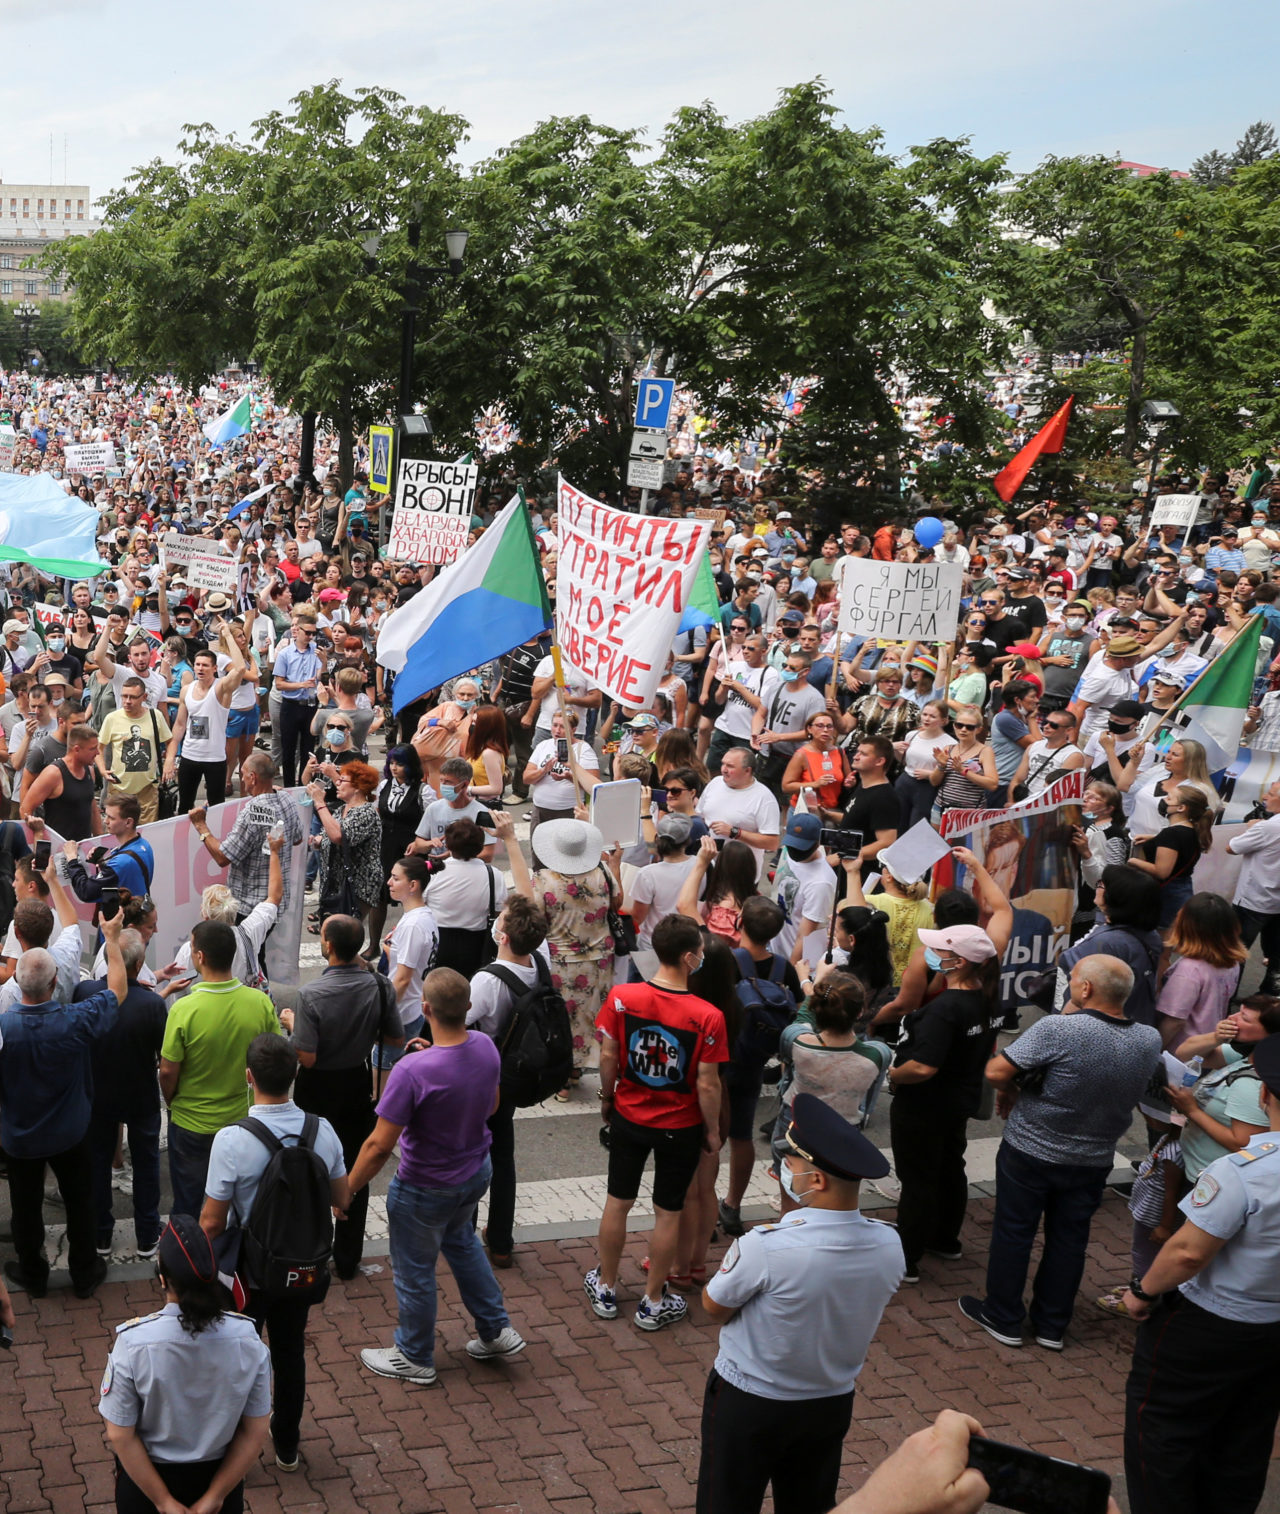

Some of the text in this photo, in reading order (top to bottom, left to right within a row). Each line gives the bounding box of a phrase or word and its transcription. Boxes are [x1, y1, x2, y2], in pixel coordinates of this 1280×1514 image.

[402, 484, 475, 516] ВОН!
[395, 511, 466, 533] БЕЛАРУСЬ
[392, 526, 467, 548] ХАБАРОВСК
[394, 541, 458, 565] РЯДОМ
[560, 526, 682, 613] УТРАТИЛ
[880, 566, 940, 589] Я МЫ
[853, 584, 952, 612] СЕРГЕЙ
[850, 607, 937, 636] ФУРГАЛ
[638, 1029, 678, 1060] The
[630, 1049, 681, 1081] Who
